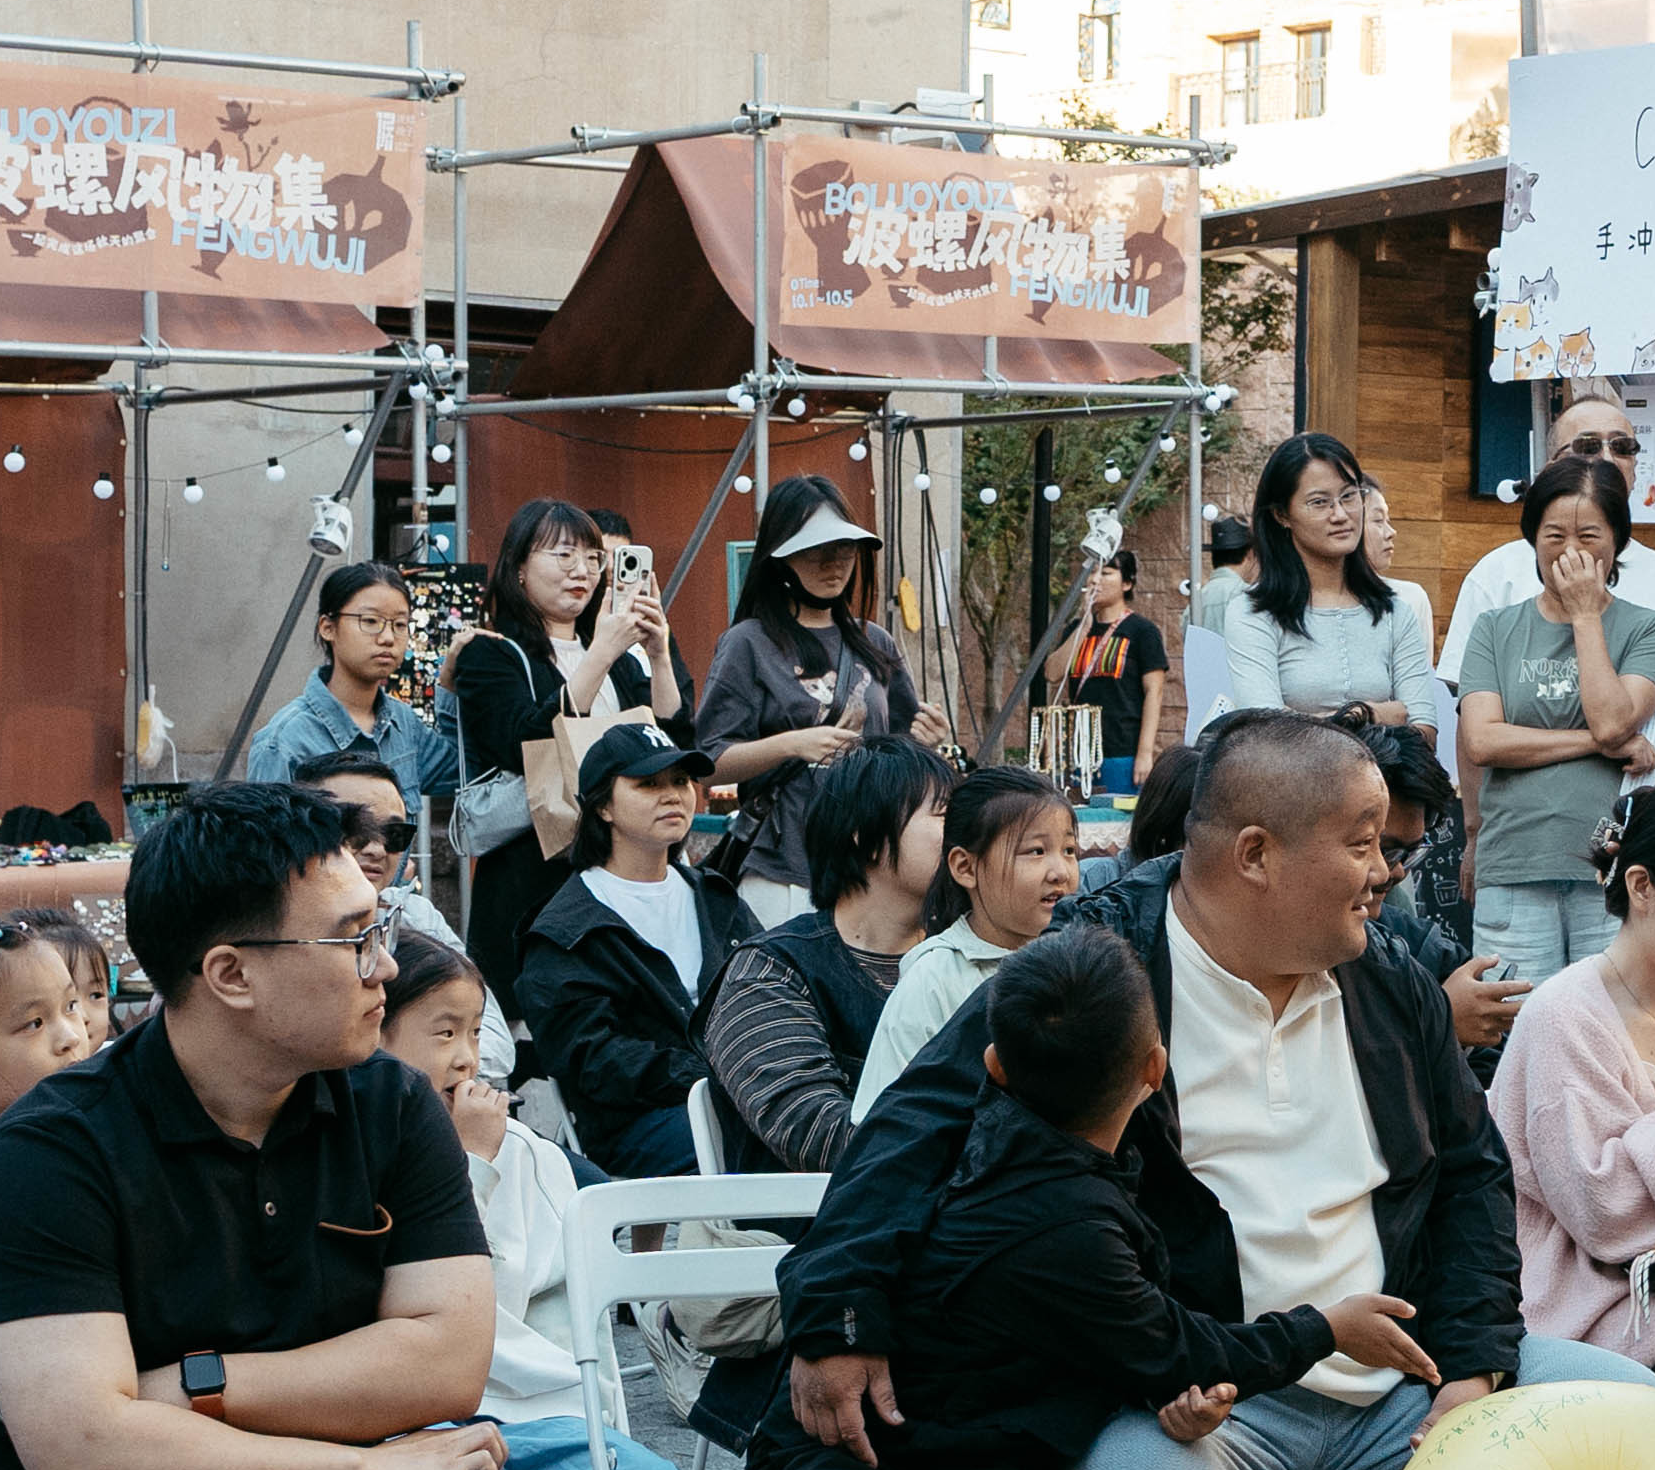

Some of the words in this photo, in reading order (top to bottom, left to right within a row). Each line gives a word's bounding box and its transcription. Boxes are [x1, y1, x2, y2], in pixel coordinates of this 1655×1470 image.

[843, 201, 1130, 283] 波螺风物集
